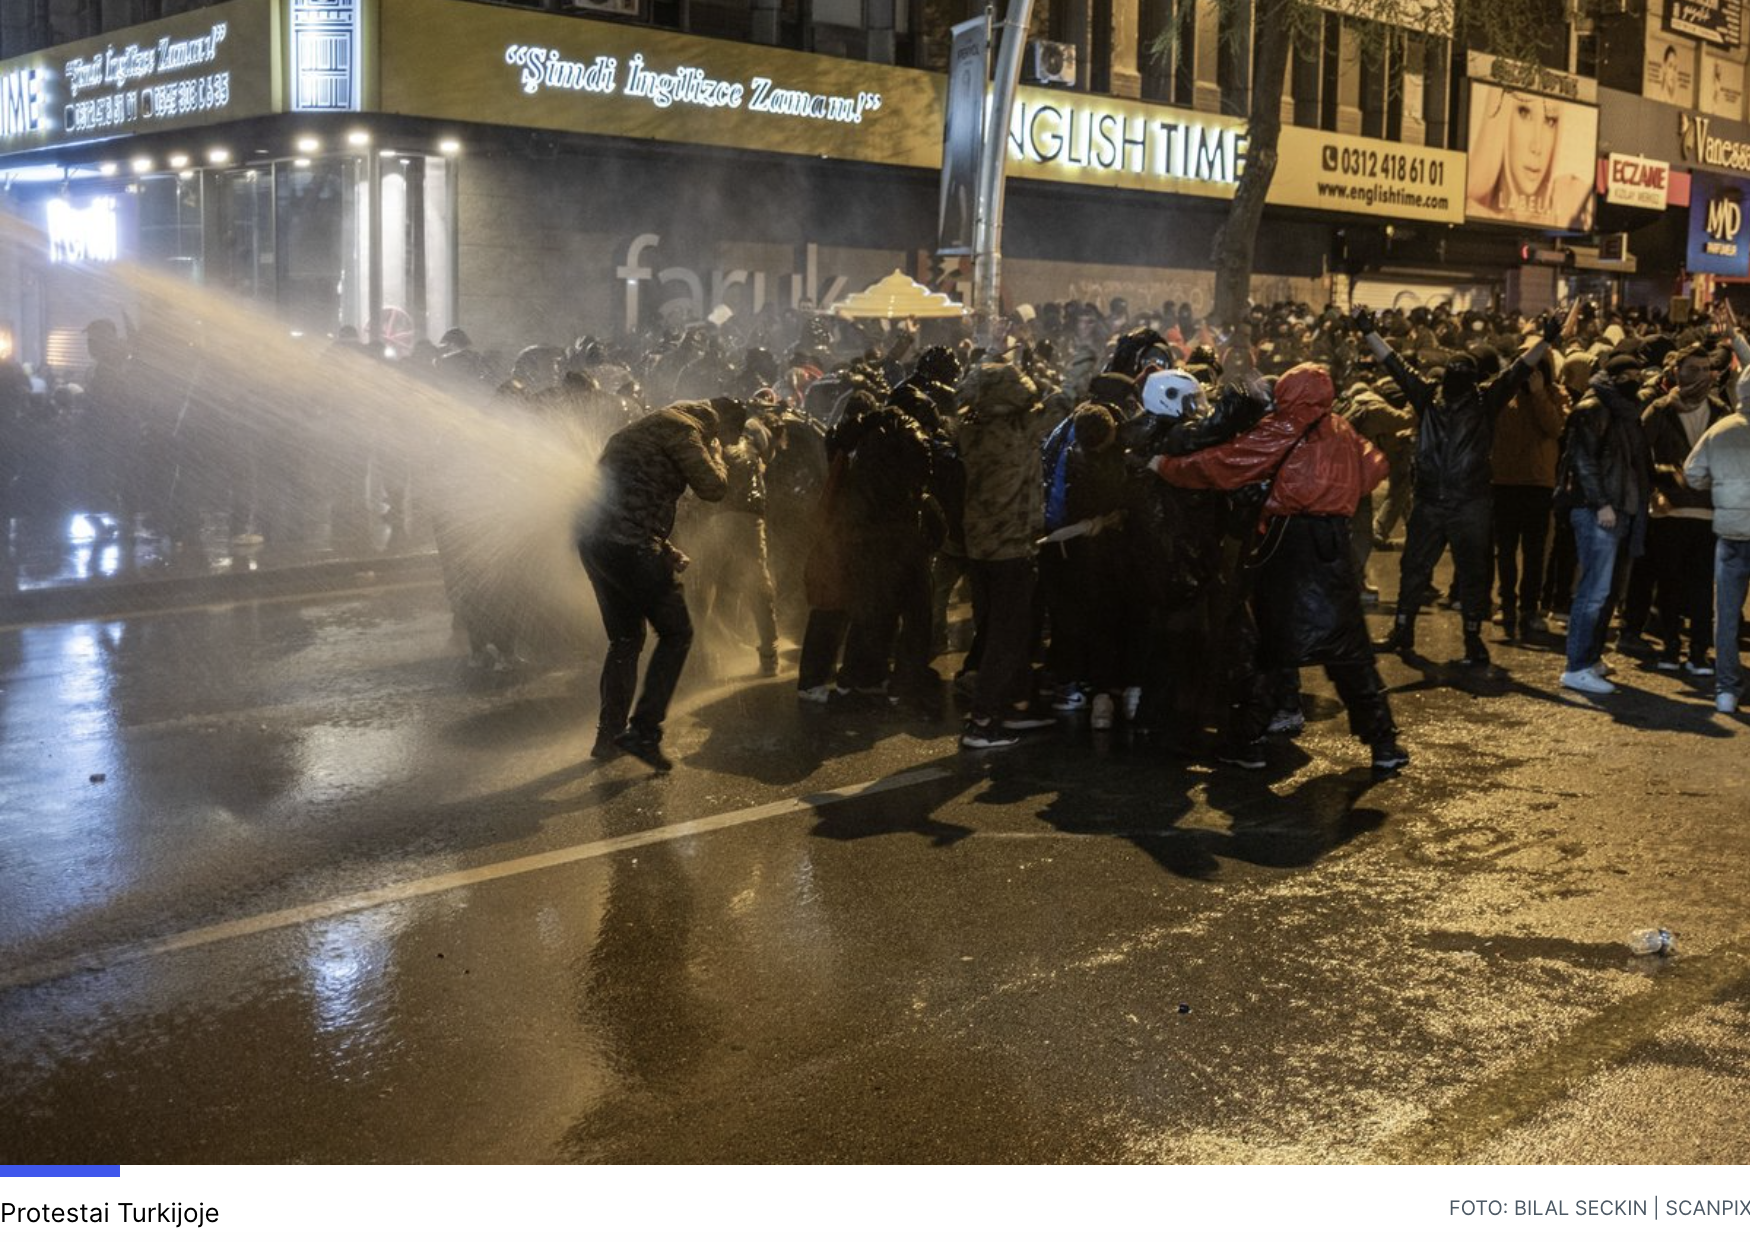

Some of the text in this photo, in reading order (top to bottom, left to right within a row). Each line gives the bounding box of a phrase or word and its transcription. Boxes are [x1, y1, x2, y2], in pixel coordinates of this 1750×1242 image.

[623, 53, 745, 108] İngilizce
[1009, 102, 1249, 182] NGLISH TIME
[1341, 147, 1444, 186] 0312 418 61 01
[1613, 160, 1666, 190] ECZANE
[1317, 181, 1449, 210] www.englishtime.com
[616, 233, 848, 333] faruk
